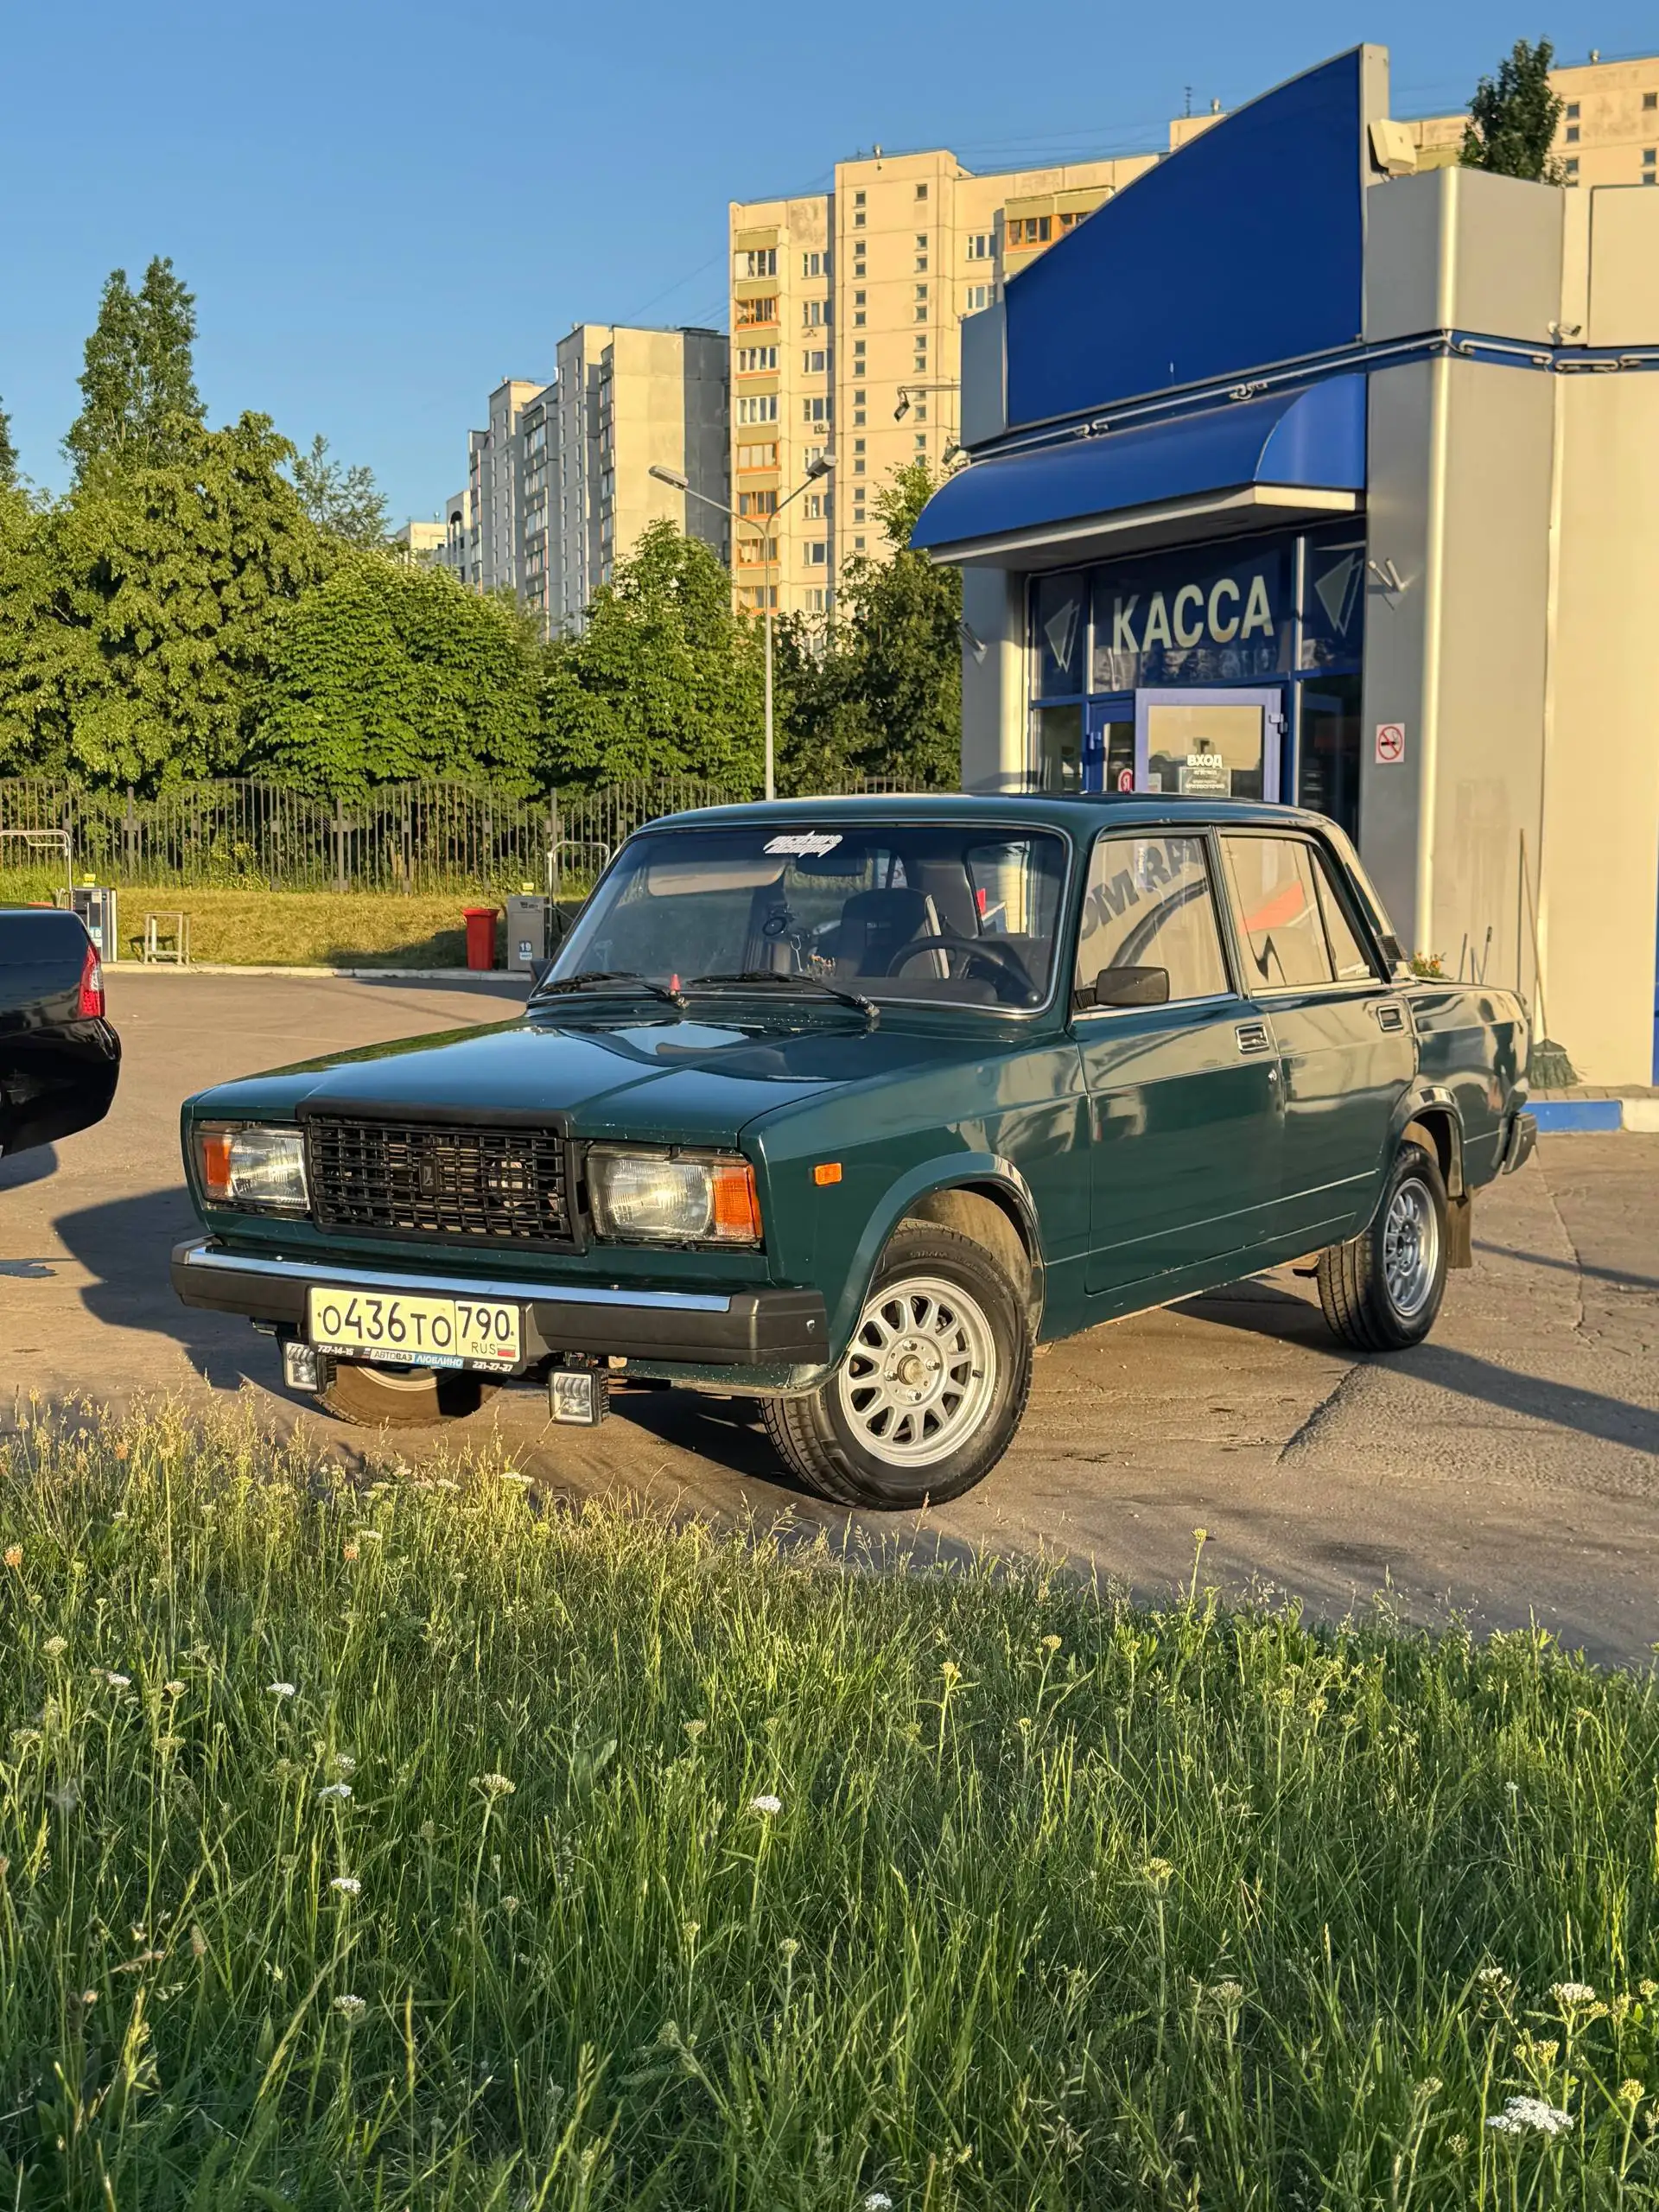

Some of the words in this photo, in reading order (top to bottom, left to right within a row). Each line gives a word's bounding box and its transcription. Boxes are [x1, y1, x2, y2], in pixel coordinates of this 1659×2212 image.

[1113, 575, 1274, 655] КАССА
[1186, 753, 1223, 768] ВХОД
[322, 1298, 452, 1347] О436ТО
[458, 1306, 510, 1341] 790
[471, 1342, 496, 1355] RUS
[374, 1351, 413, 1362] АВТОВАЗ
[416, 1355, 463, 1367] ЛЮБЛИНО
